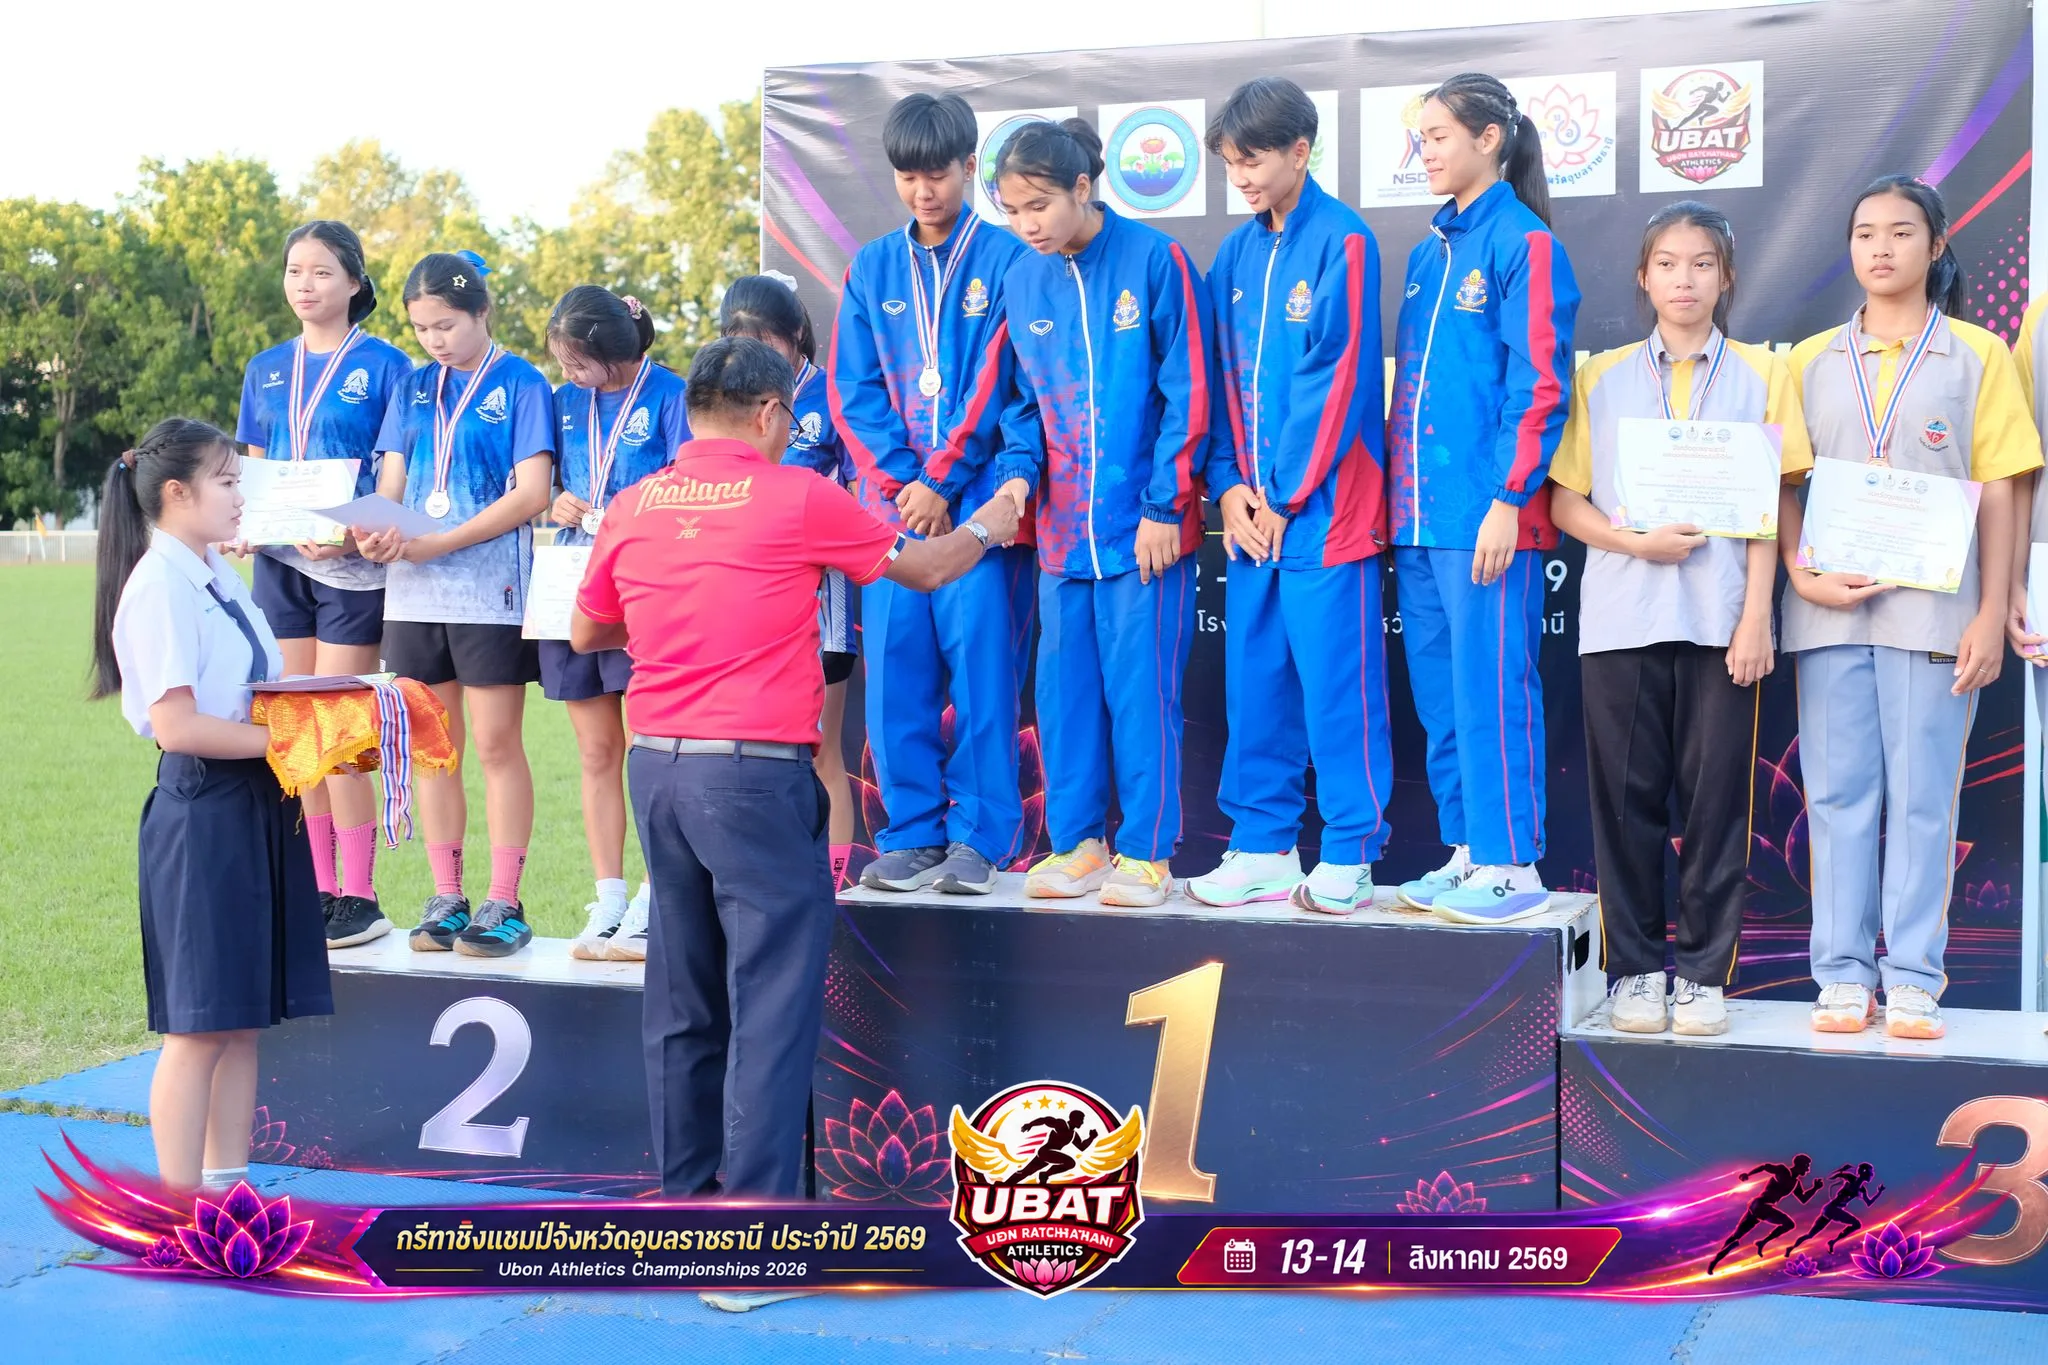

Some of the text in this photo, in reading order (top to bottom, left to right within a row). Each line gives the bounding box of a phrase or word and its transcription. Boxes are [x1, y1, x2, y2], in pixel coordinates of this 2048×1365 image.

[1393, 172, 1428, 185] NSD
[1660, 125, 1745, 152] UBAT
[634, 473, 754, 517] Thailand
[418, 996, 532, 1158] 2
[1125, 961, 1226, 1203] 1
[1936, 1095, 2048, 1265] 3
